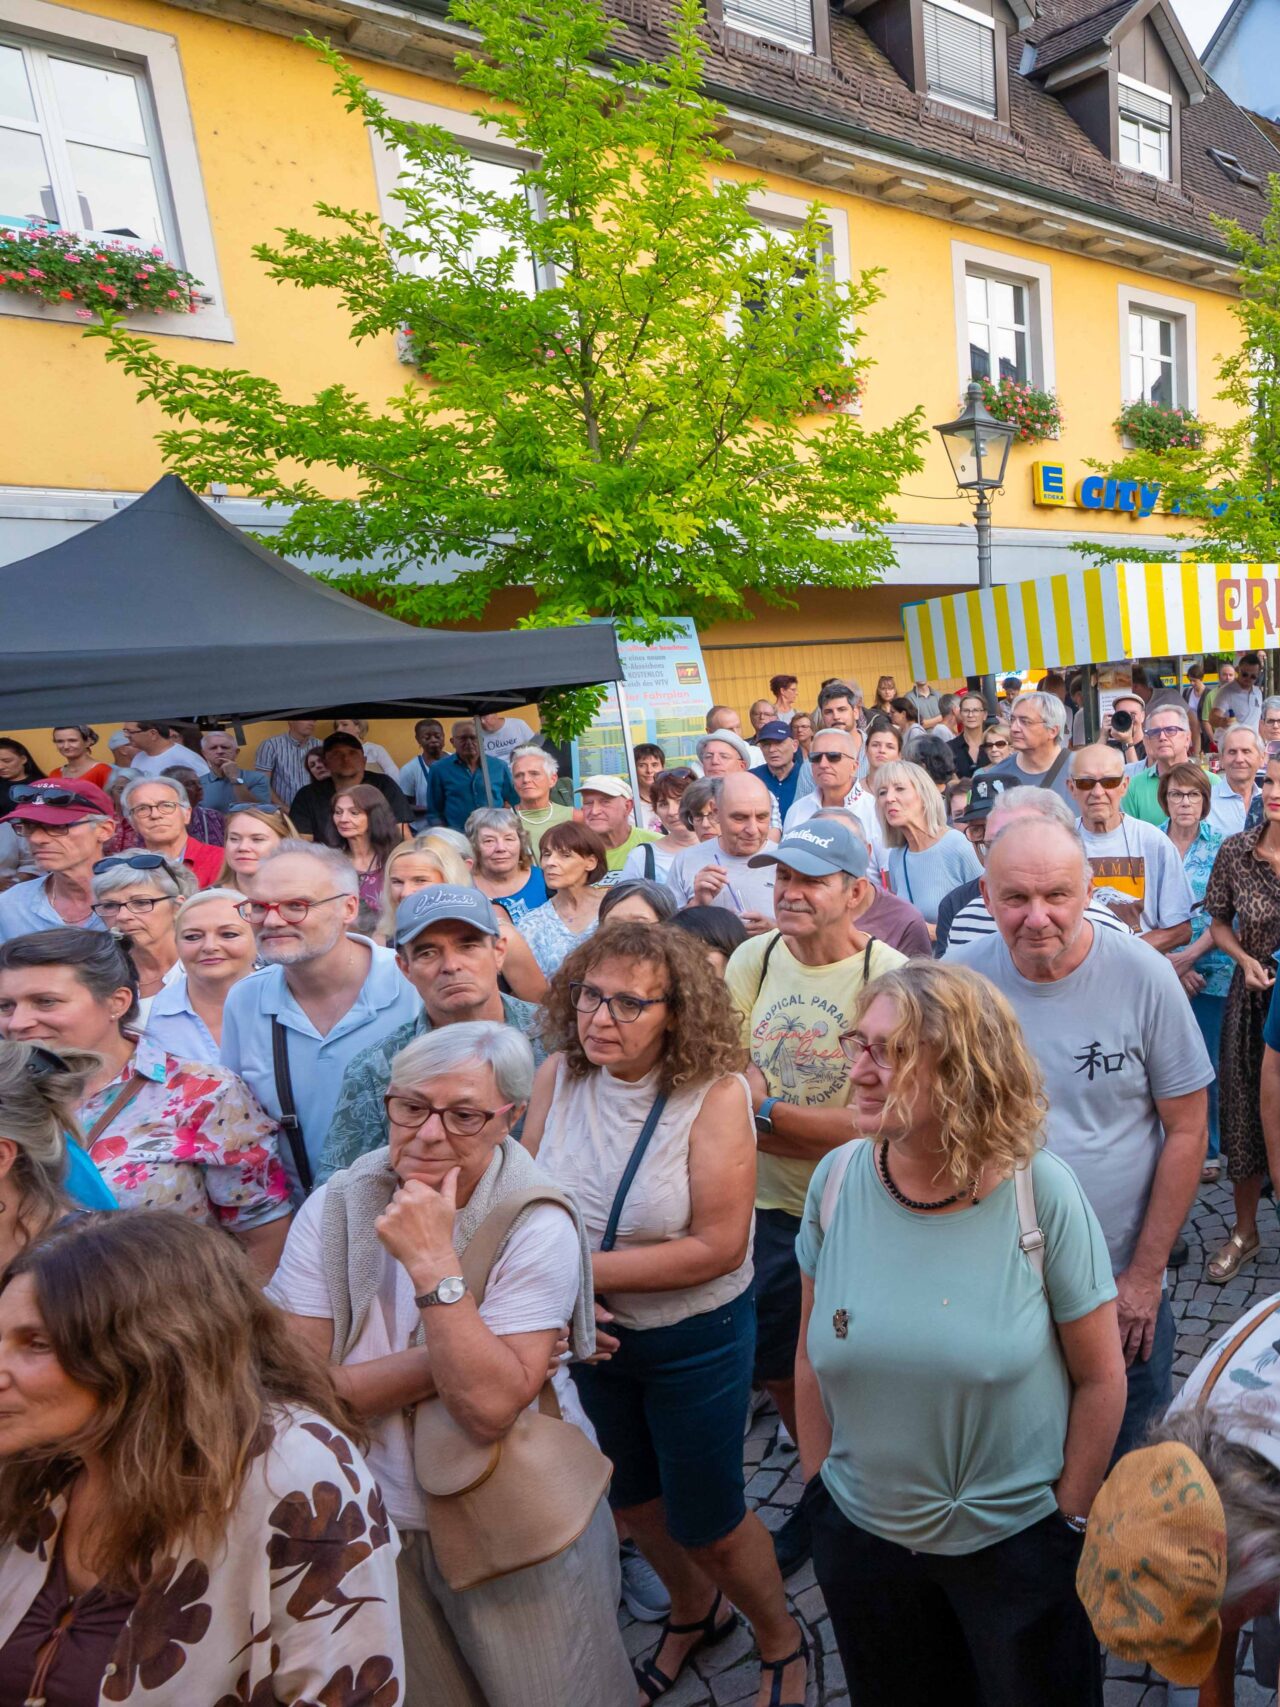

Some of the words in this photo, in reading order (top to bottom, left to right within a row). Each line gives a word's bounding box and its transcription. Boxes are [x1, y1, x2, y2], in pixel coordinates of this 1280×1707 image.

[1043, 493, 1065, 501] EDEKA
[757, 993, 806, 1036] TROPICAL
[1073, 1040, 1126, 1081] 和
[804, 1063, 852, 1106] MOMENT
